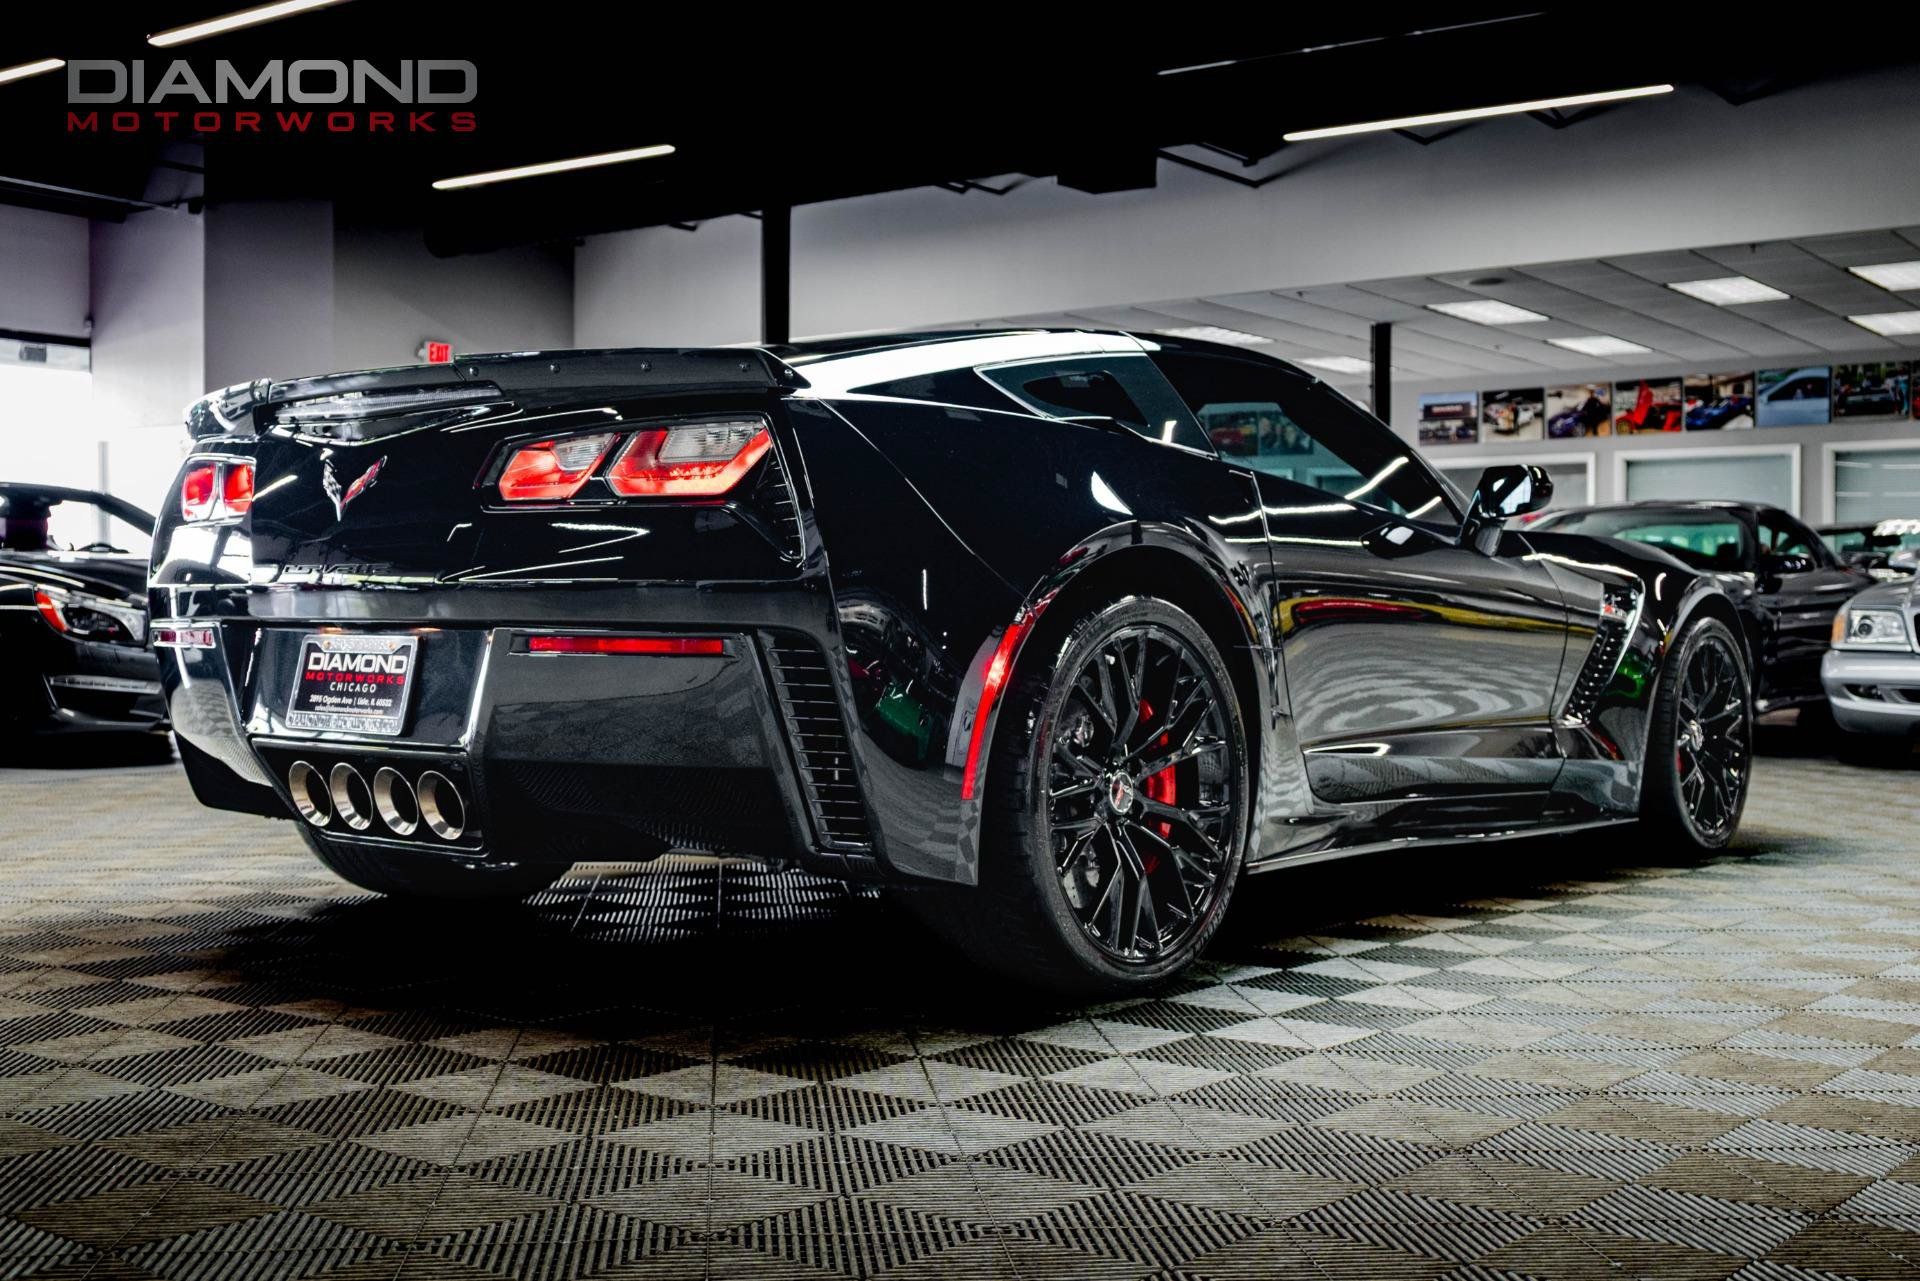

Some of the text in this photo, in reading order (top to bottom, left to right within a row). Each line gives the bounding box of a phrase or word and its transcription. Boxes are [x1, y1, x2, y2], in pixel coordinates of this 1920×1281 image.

[429, 342, 449, 362] EXIT
[307, 652, 408, 674] DIAMOND
[305, 671, 406, 685] MOTORWORKS
[329, 682, 377, 693] CHICAGO
[322, 695, 341, 704] Ogden
